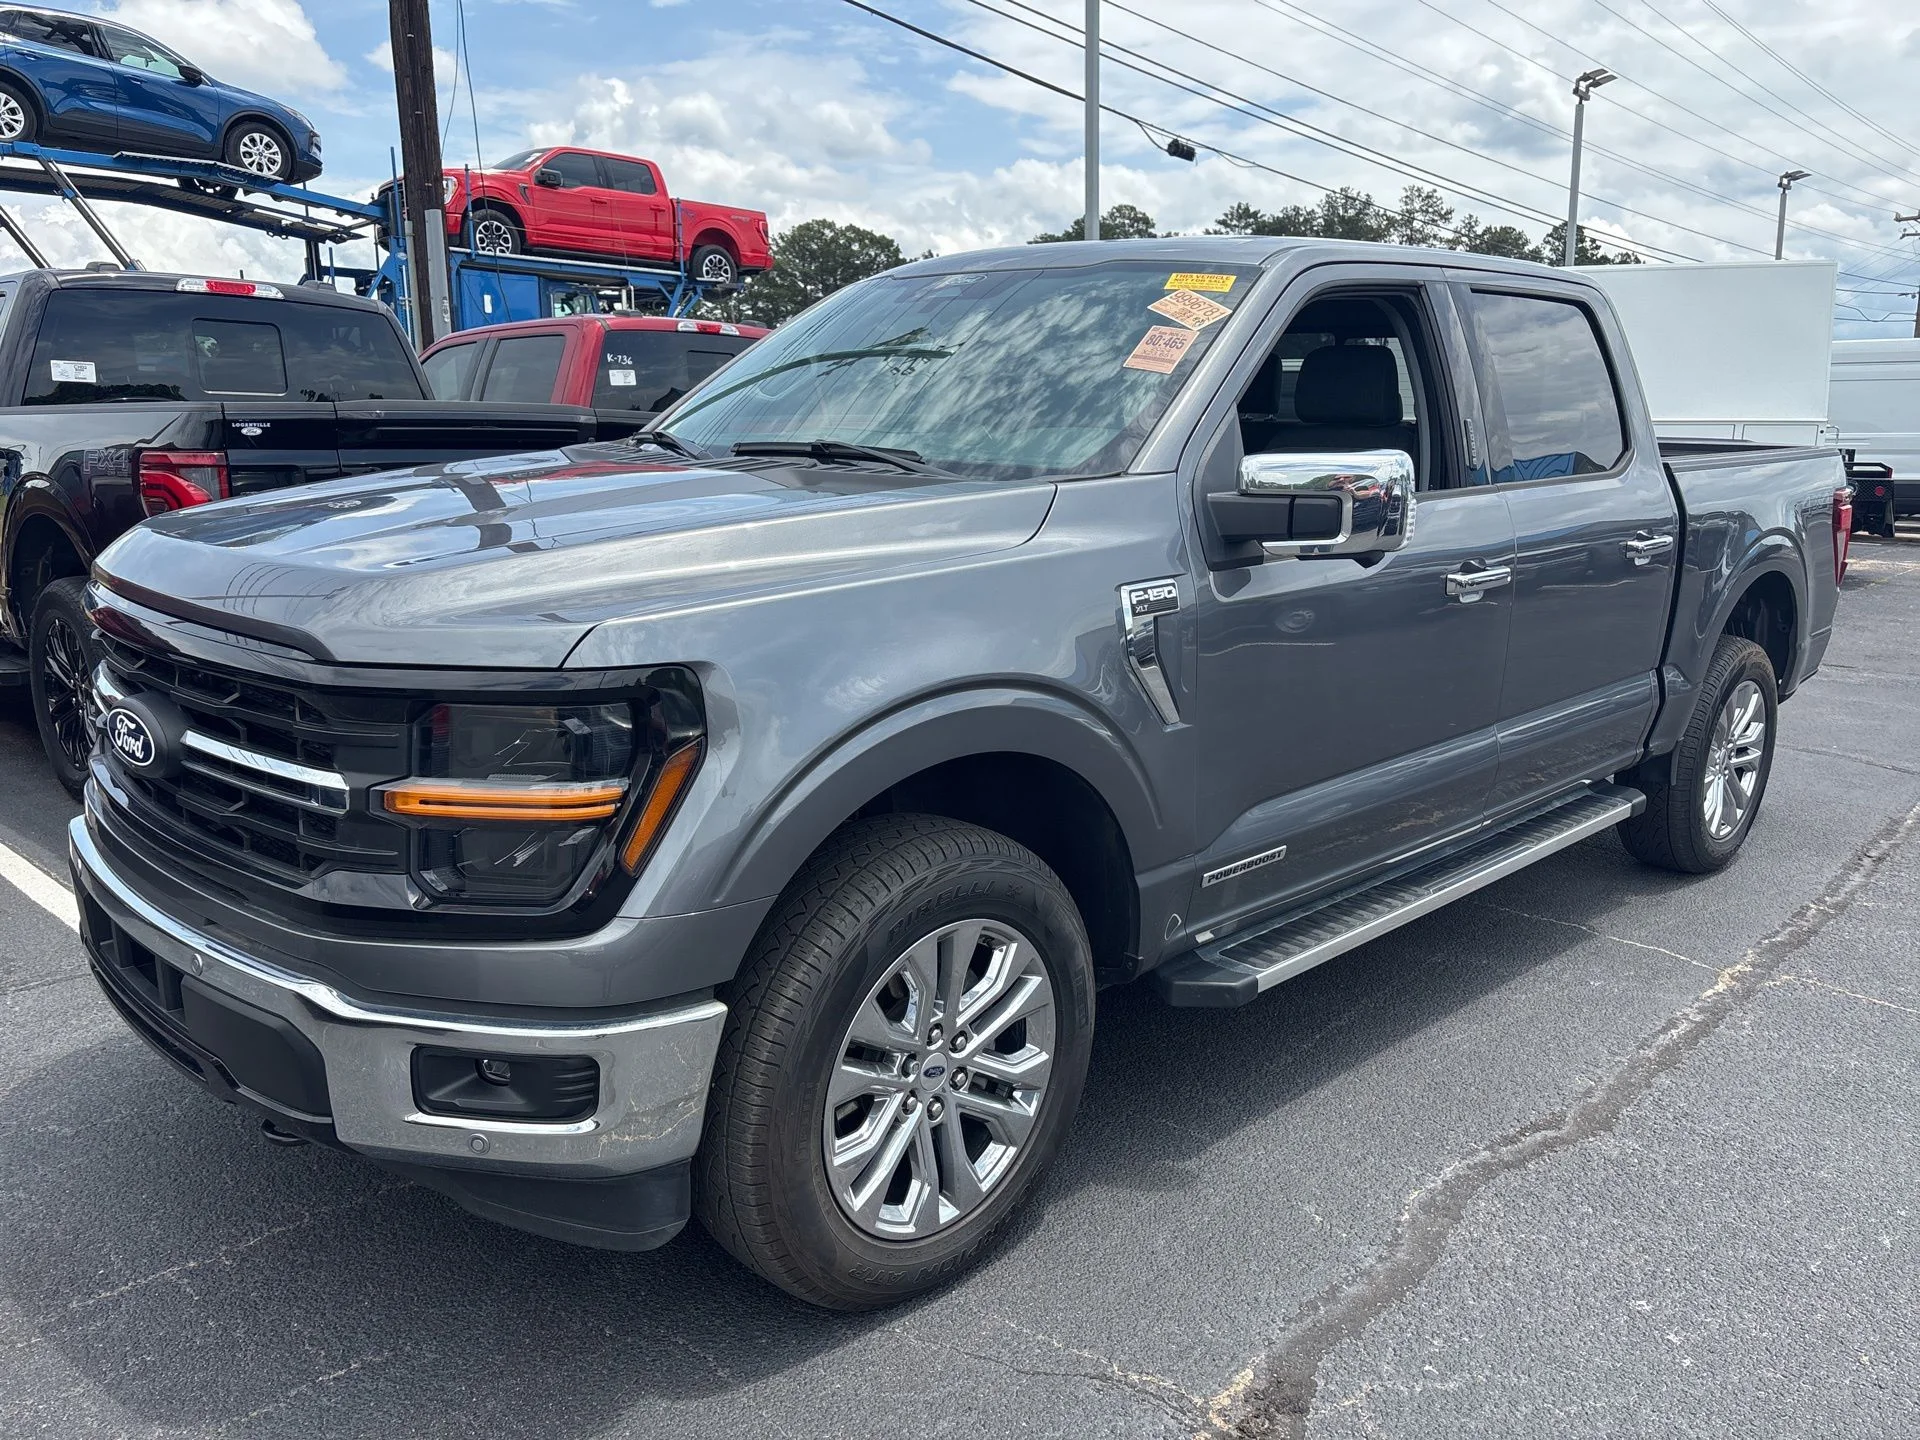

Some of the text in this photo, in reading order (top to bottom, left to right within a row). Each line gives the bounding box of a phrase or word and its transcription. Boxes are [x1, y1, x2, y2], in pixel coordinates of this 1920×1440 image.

[607, 353, 633, 365] K-736
[83, 448, 129, 475] FX4
[1130, 585, 1177, 605] F-150
[1135, 604, 1149, 614] XLT
[115, 714, 145, 760] Ford
[1207, 849, 1284, 884] POWERBOOST
[887, 879, 996, 941] PIRELLI
